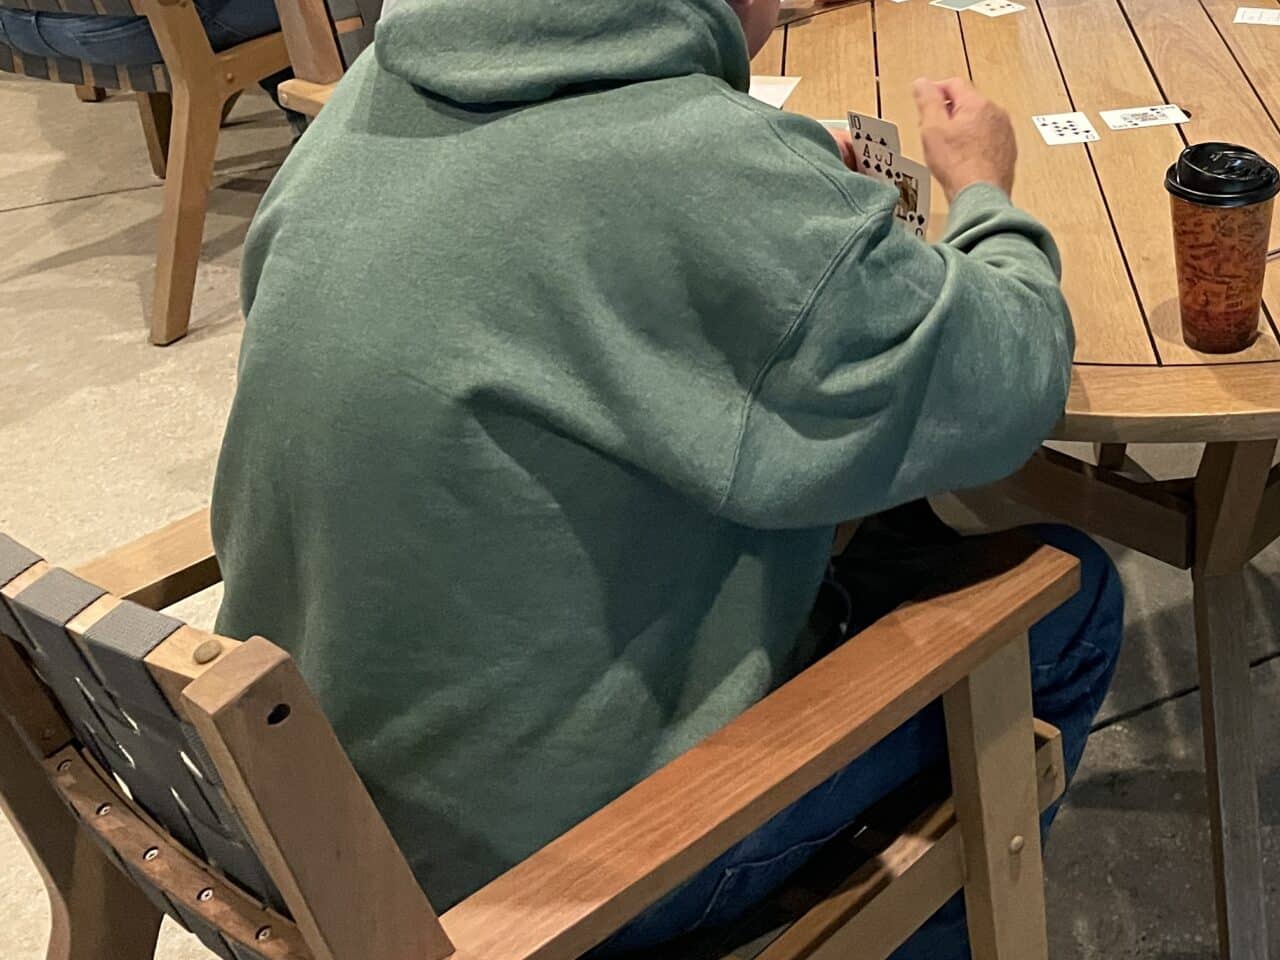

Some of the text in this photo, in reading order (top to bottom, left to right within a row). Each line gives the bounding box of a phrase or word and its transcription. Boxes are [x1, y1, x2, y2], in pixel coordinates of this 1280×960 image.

[850, 114, 862, 131] 10
[863, 143, 872, 159] A
[884, 151, 894, 167] J
